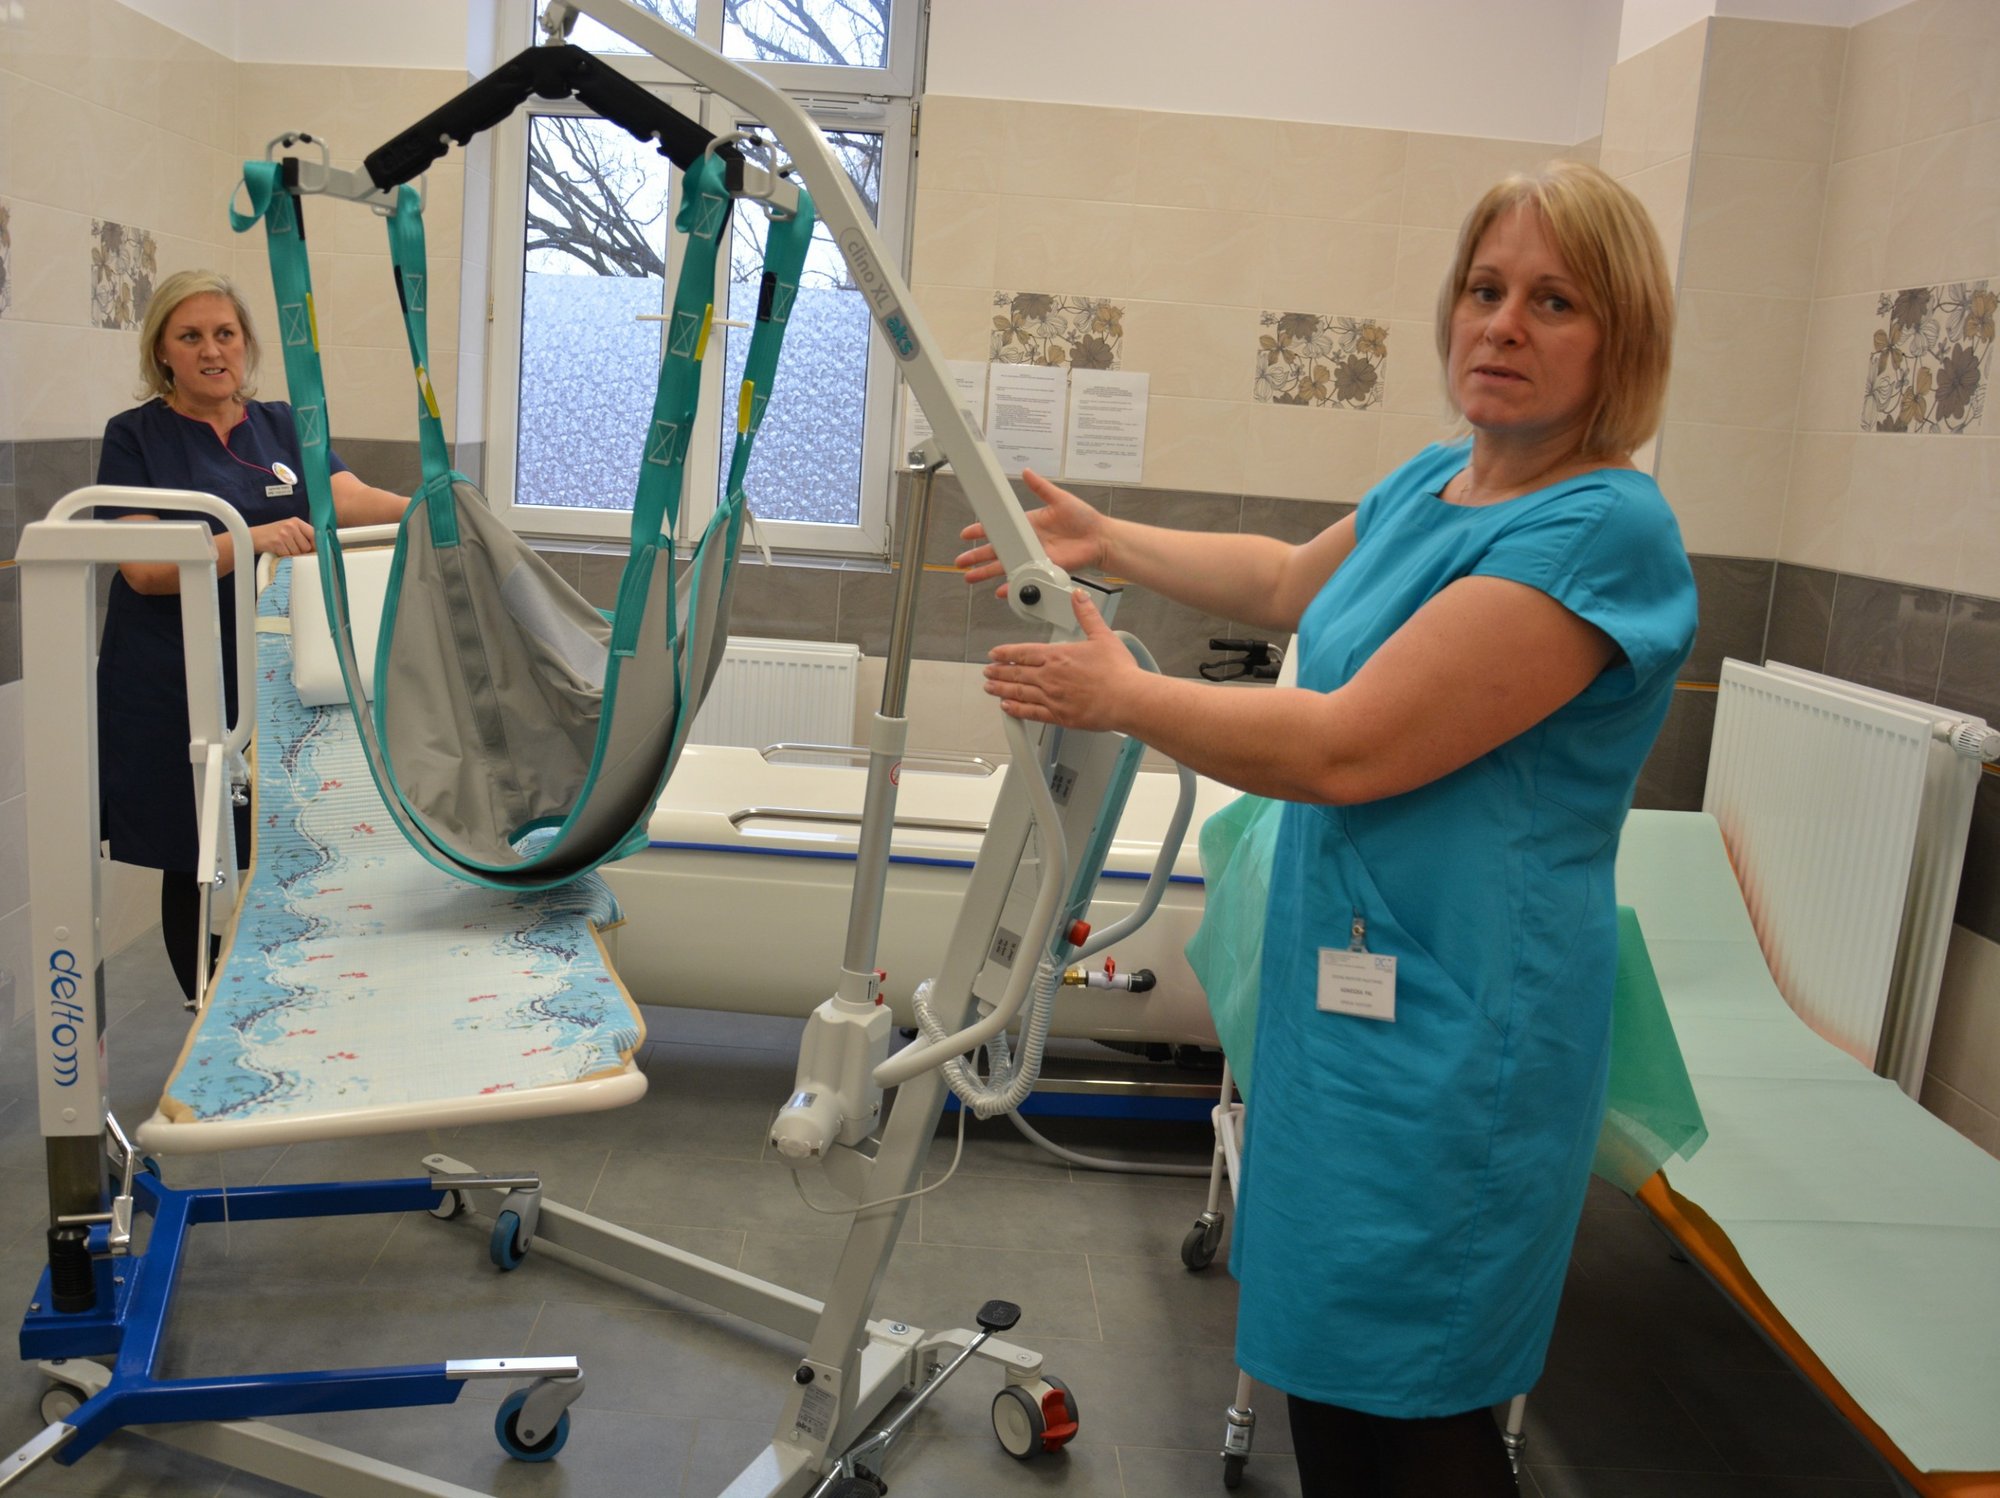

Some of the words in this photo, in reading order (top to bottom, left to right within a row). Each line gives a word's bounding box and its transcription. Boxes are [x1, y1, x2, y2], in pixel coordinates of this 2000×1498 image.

[847, 241, 875, 284] clino
[871, 283, 891, 309] XL
[887, 315, 914, 356] aks
[49, 949, 83, 1087] deltom
